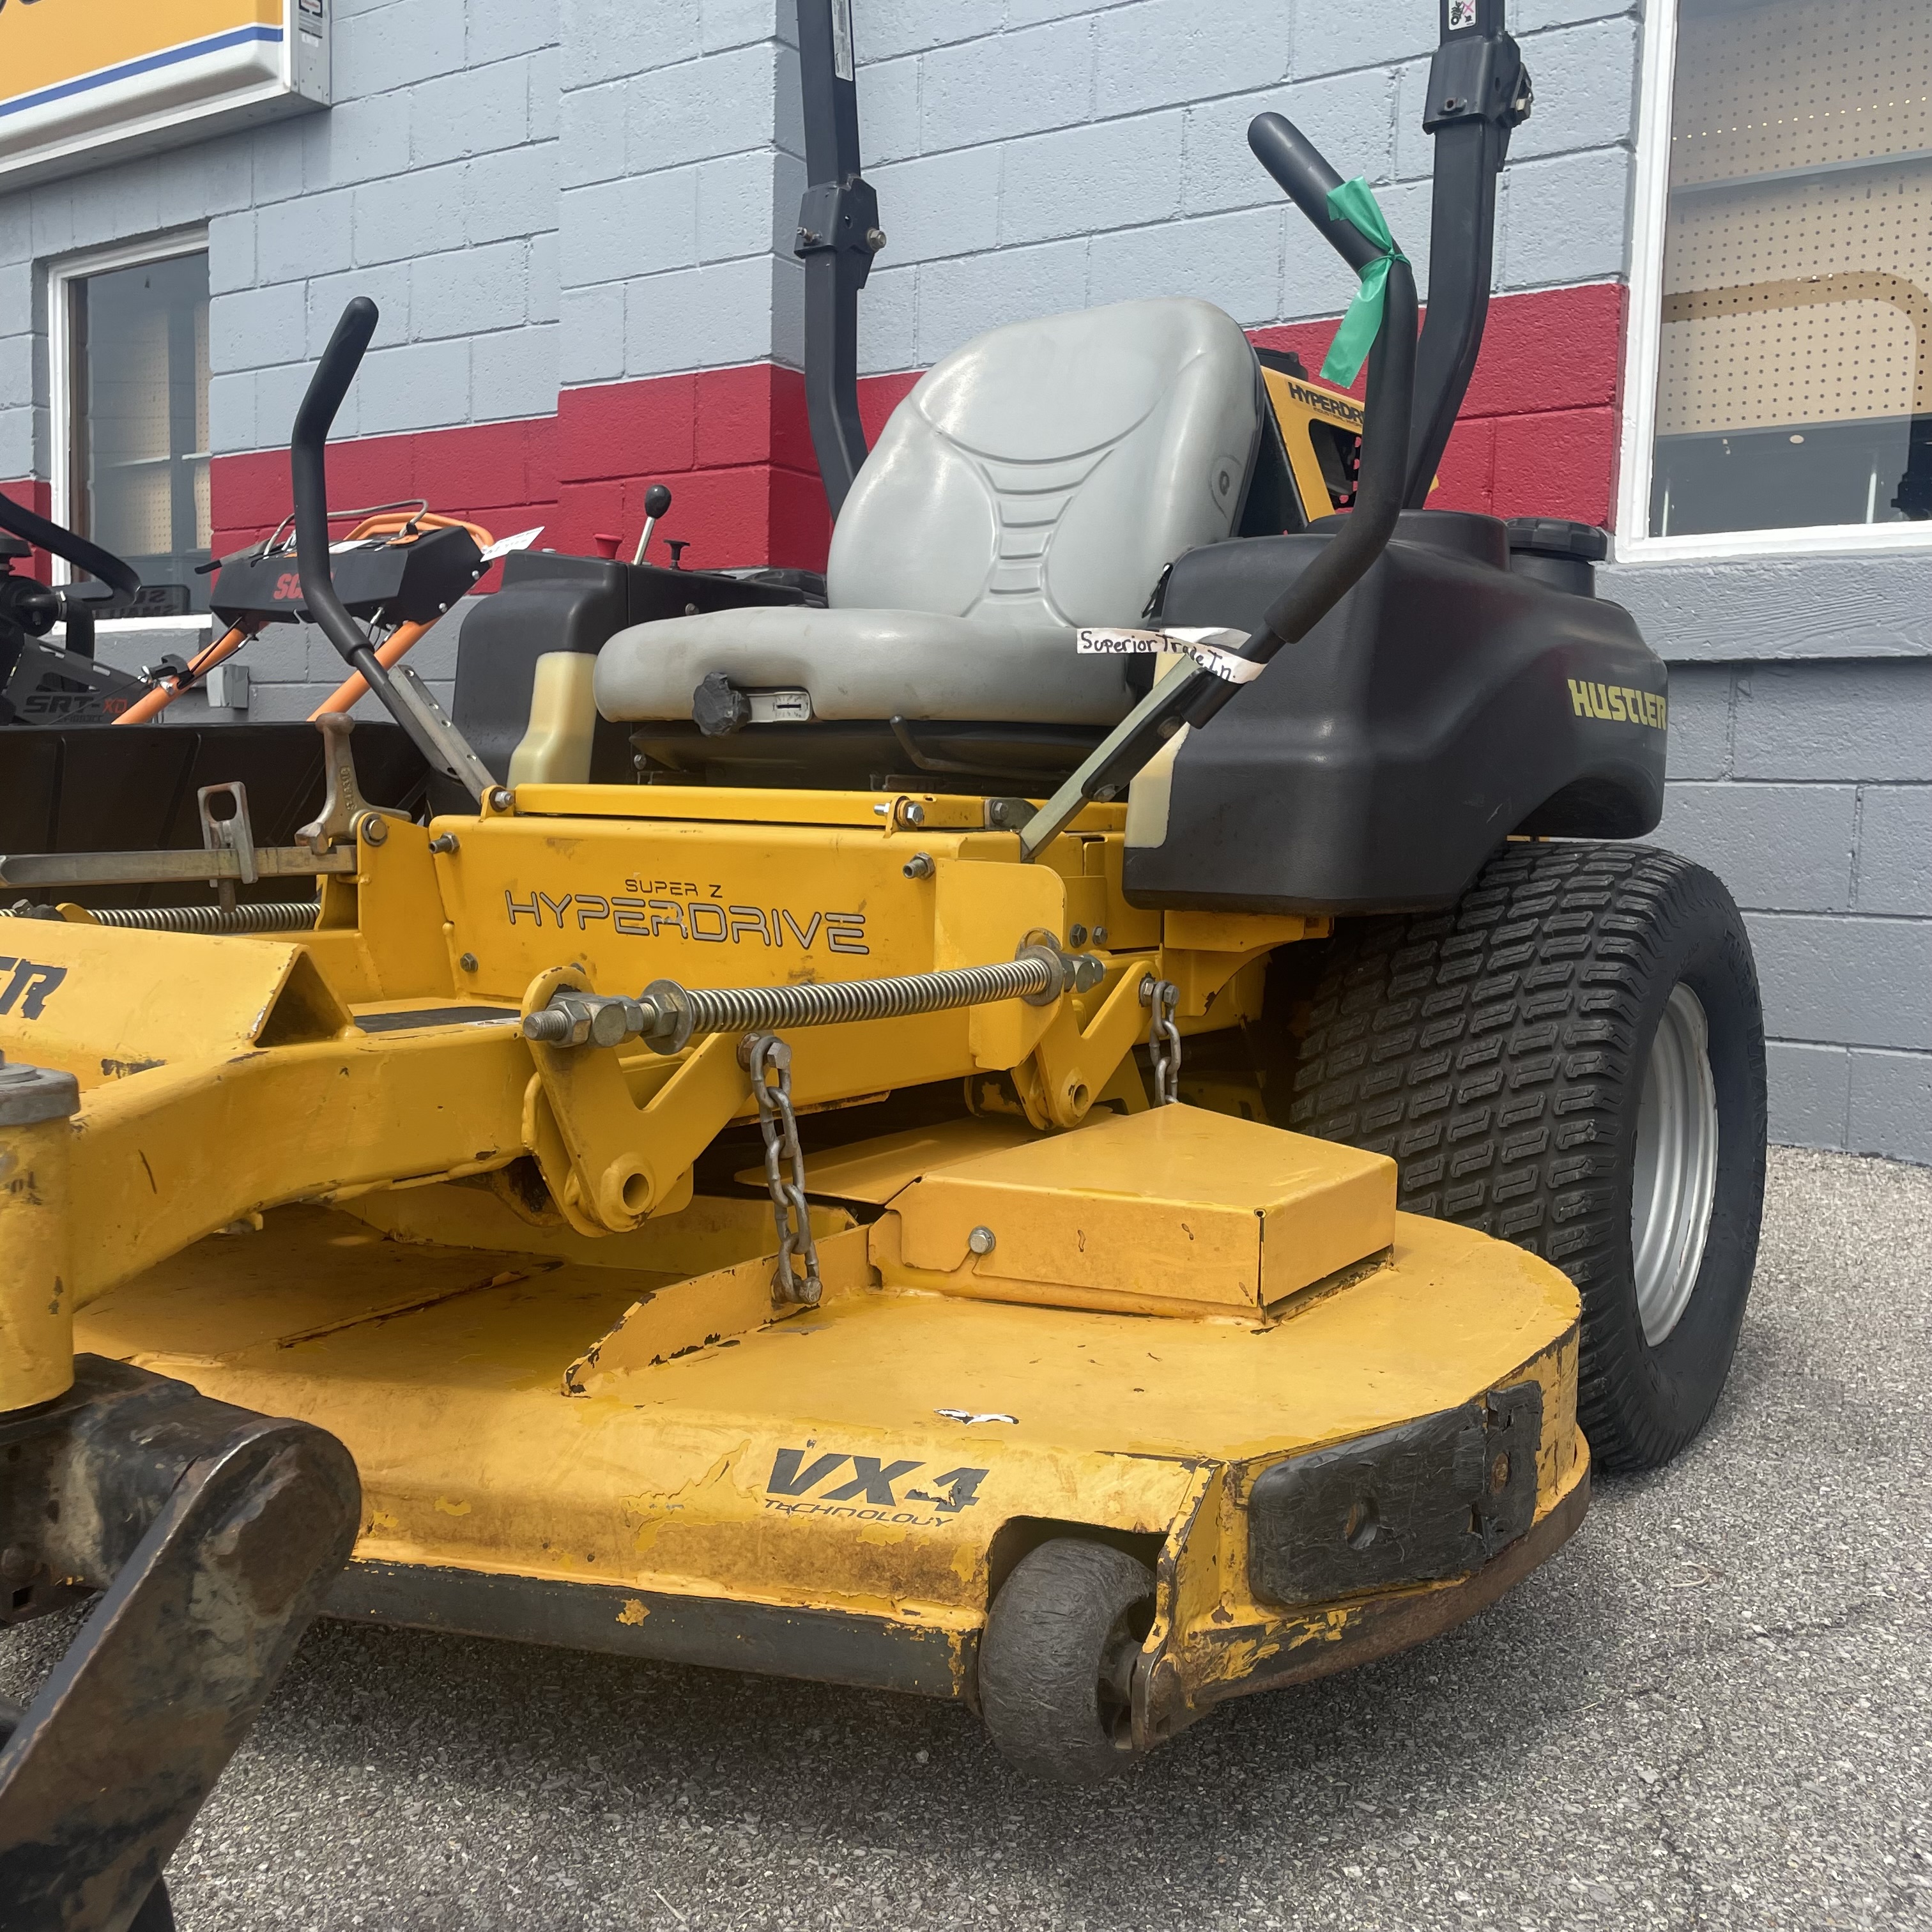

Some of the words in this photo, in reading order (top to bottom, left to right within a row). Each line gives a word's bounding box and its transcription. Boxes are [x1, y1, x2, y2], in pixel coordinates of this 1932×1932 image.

[1080, 630, 1158, 654] Superior
[1155, 633, 1204, 666] Trade
[1567, 678, 1667, 730] HUSTLER
[625, 878, 698, 896] SUPER
[709, 884, 723, 898] Z
[505, 889, 870, 955] HYPERDRIVE
[0, 956, 68, 1021] R
